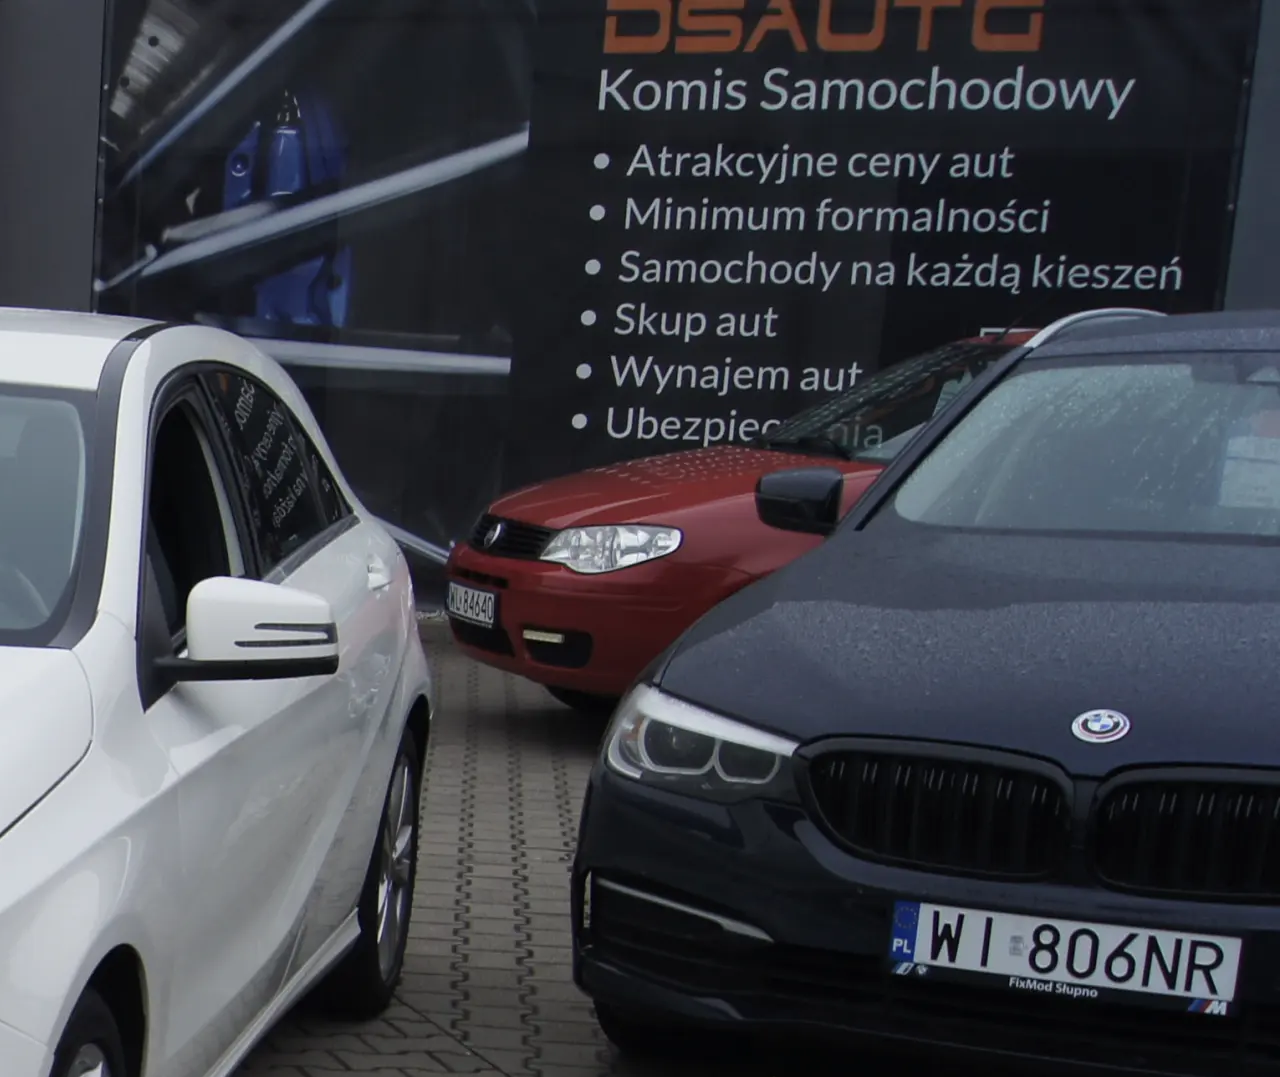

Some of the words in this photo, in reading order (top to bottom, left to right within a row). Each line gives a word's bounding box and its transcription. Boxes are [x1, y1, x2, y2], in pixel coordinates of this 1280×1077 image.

[597, 68, 748, 112] Komis
[759, 65, 1136, 121] Samochodowy
[626, 143, 838, 184] Atrakcyjne
[847, 151, 942, 186] ceny
[948, 145, 1015, 178] aut
[623, 197, 806, 231] Minimum
[816, 197, 1051, 234] formalności
[617, 250, 842, 292] Samochody
[849, 262, 897, 286] na
[906, 253, 1021, 294] każdą
[1031, 255, 1184, 291] kieszeń
[613, 303, 707, 343] Skup
[715, 312, 779, 338] aut
[609, 354, 790, 396] Wynajem
[799, 362, 864, 392] aut
[464, 589, 494, 621] 84640
[892, 937, 912, 954] PL
[929, 909, 994, 968] WI
[1028, 923, 1225, 997] 806NR
[1008, 976, 1053, 993] FixMod
[1055, 980, 1099, 998] Słupno
